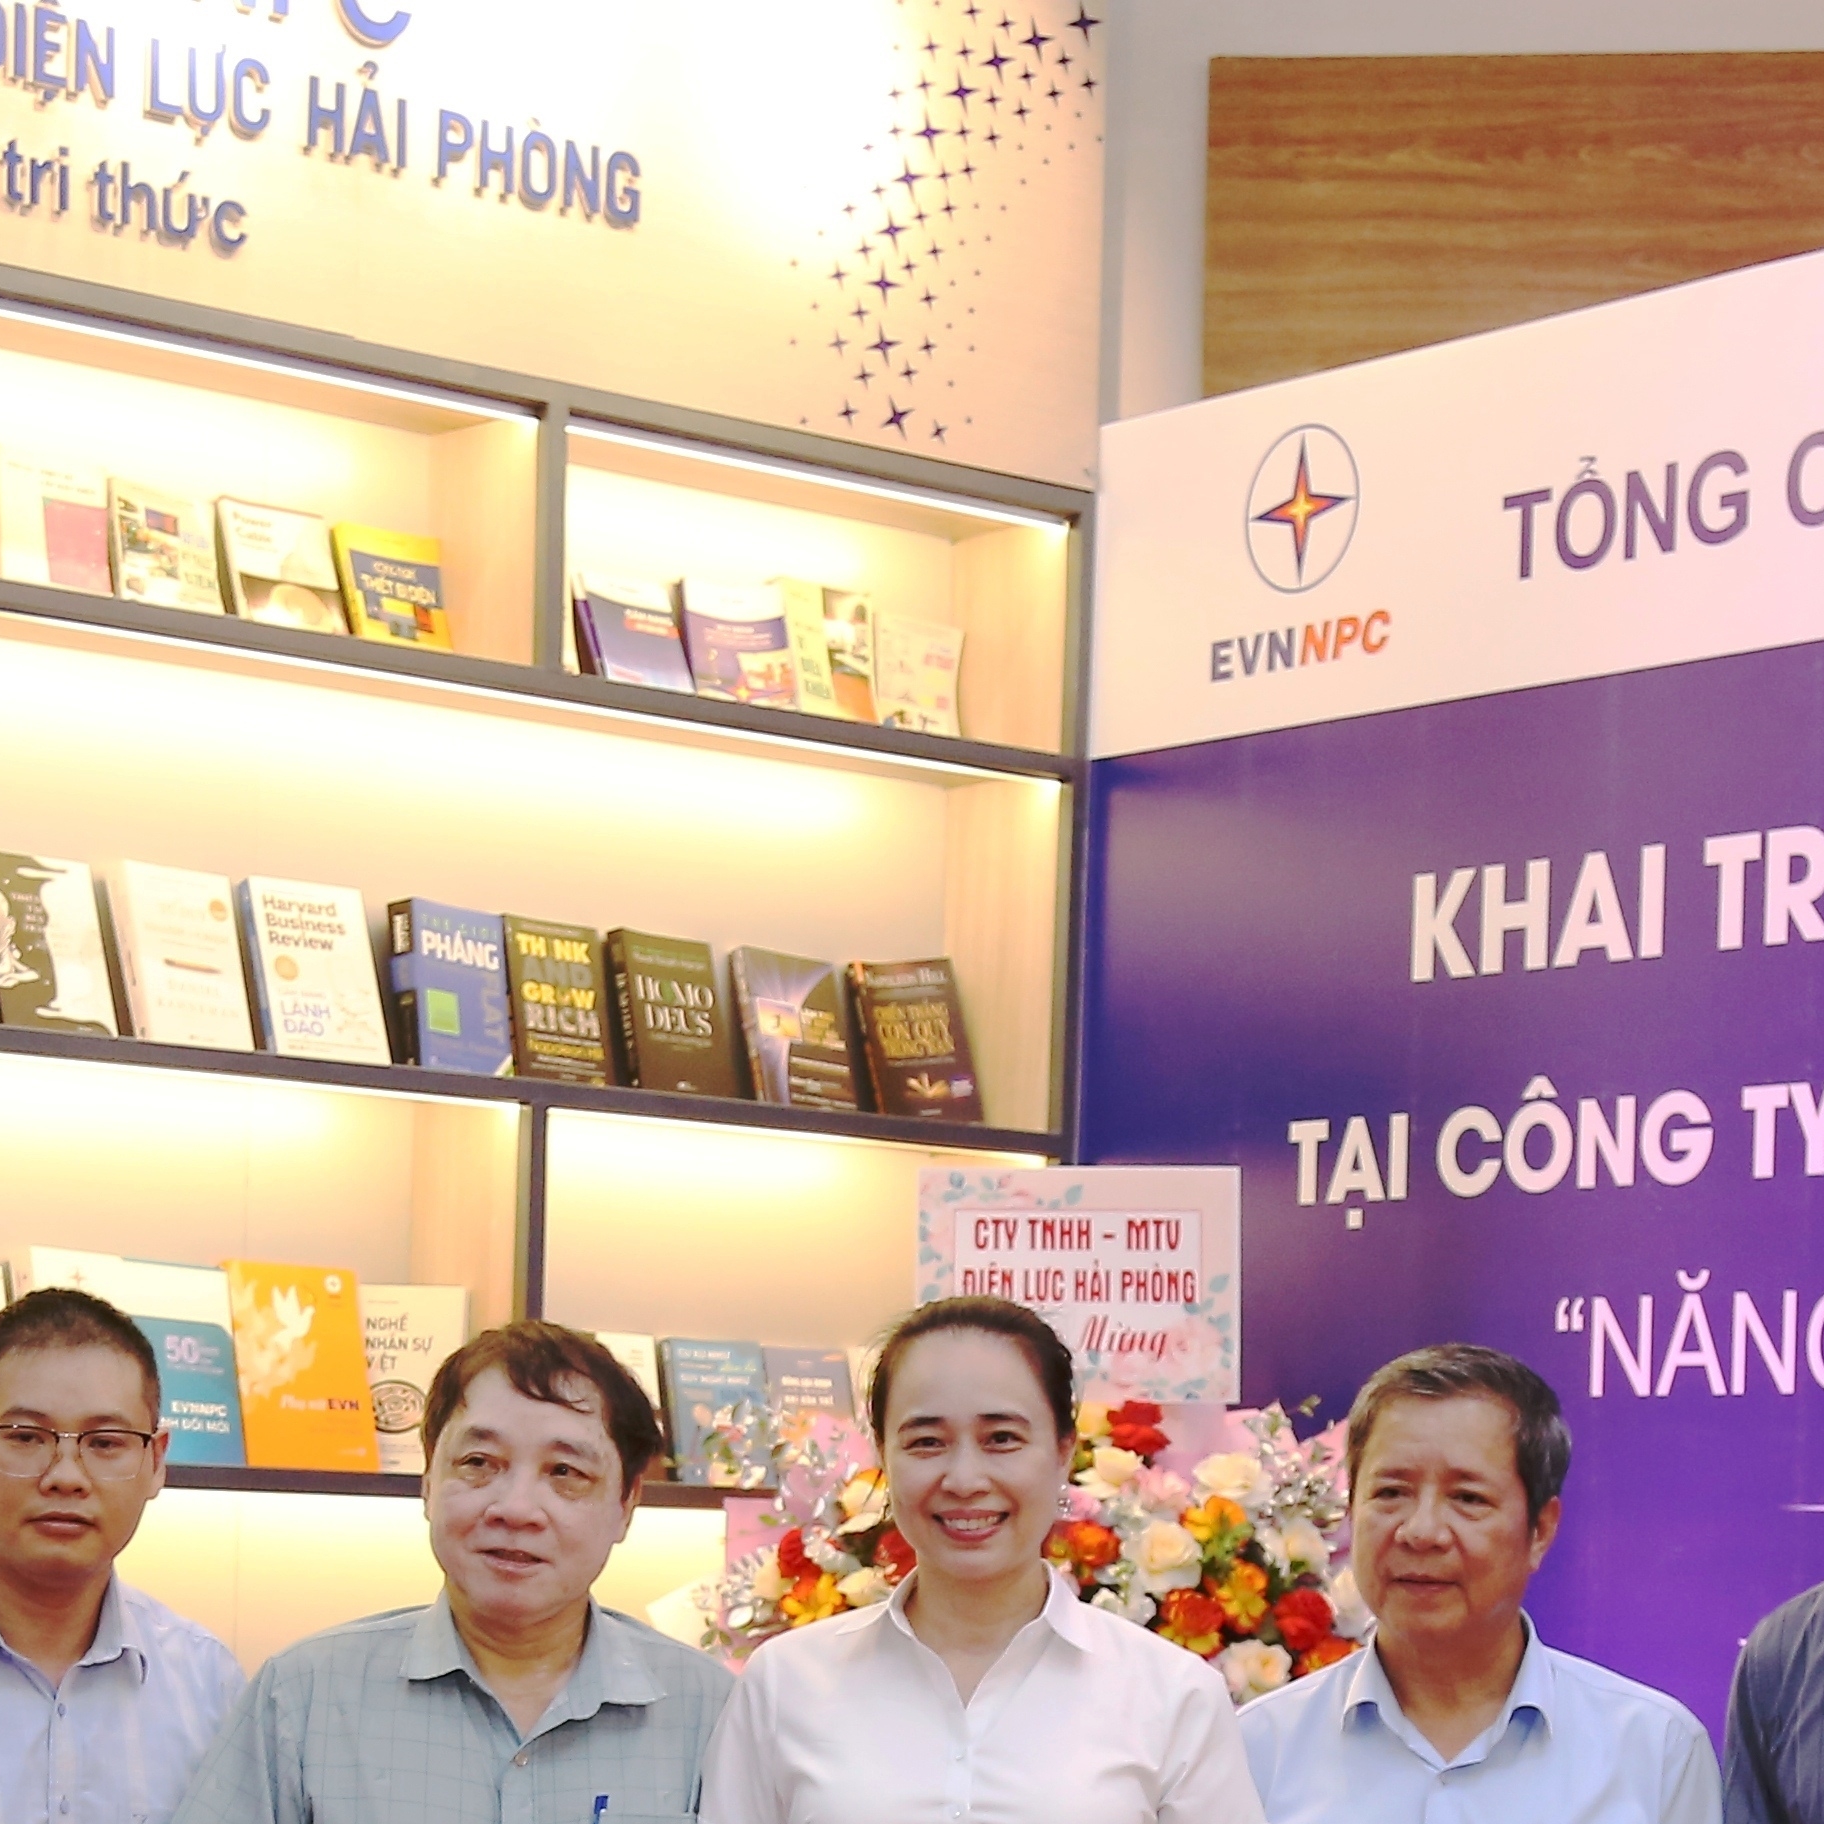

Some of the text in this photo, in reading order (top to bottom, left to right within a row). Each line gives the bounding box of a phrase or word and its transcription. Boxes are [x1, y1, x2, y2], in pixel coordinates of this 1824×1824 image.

[146, 39, 271, 142] LỰC
[305, 59, 408, 174] HẢI
[434, 117, 642, 226] PHÒNG
[1, 139, 70, 214] tri
[90, 168, 249, 250] thức
[1502, 453, 1752, 580] TỔNG
[1210, 609, 1391, 683] EVNNPC
[1409, 842, 1668, 984] KHAI
[526, 1003, 601, 1039] RICH
[1288, 1110, 1409, 1230] TẠI
[1434, 1075, 1715, 1198] CÔNG
[975, 1219, 1018, 1250] CTY
[1027, 1219, 1092, 1250] TNHH
[1127, 1219, 1182, 1250] MTV
[1075, 1259, 1112, 1303] HẢI
[1121, 1263, 1198, 1303] PHÒNG
